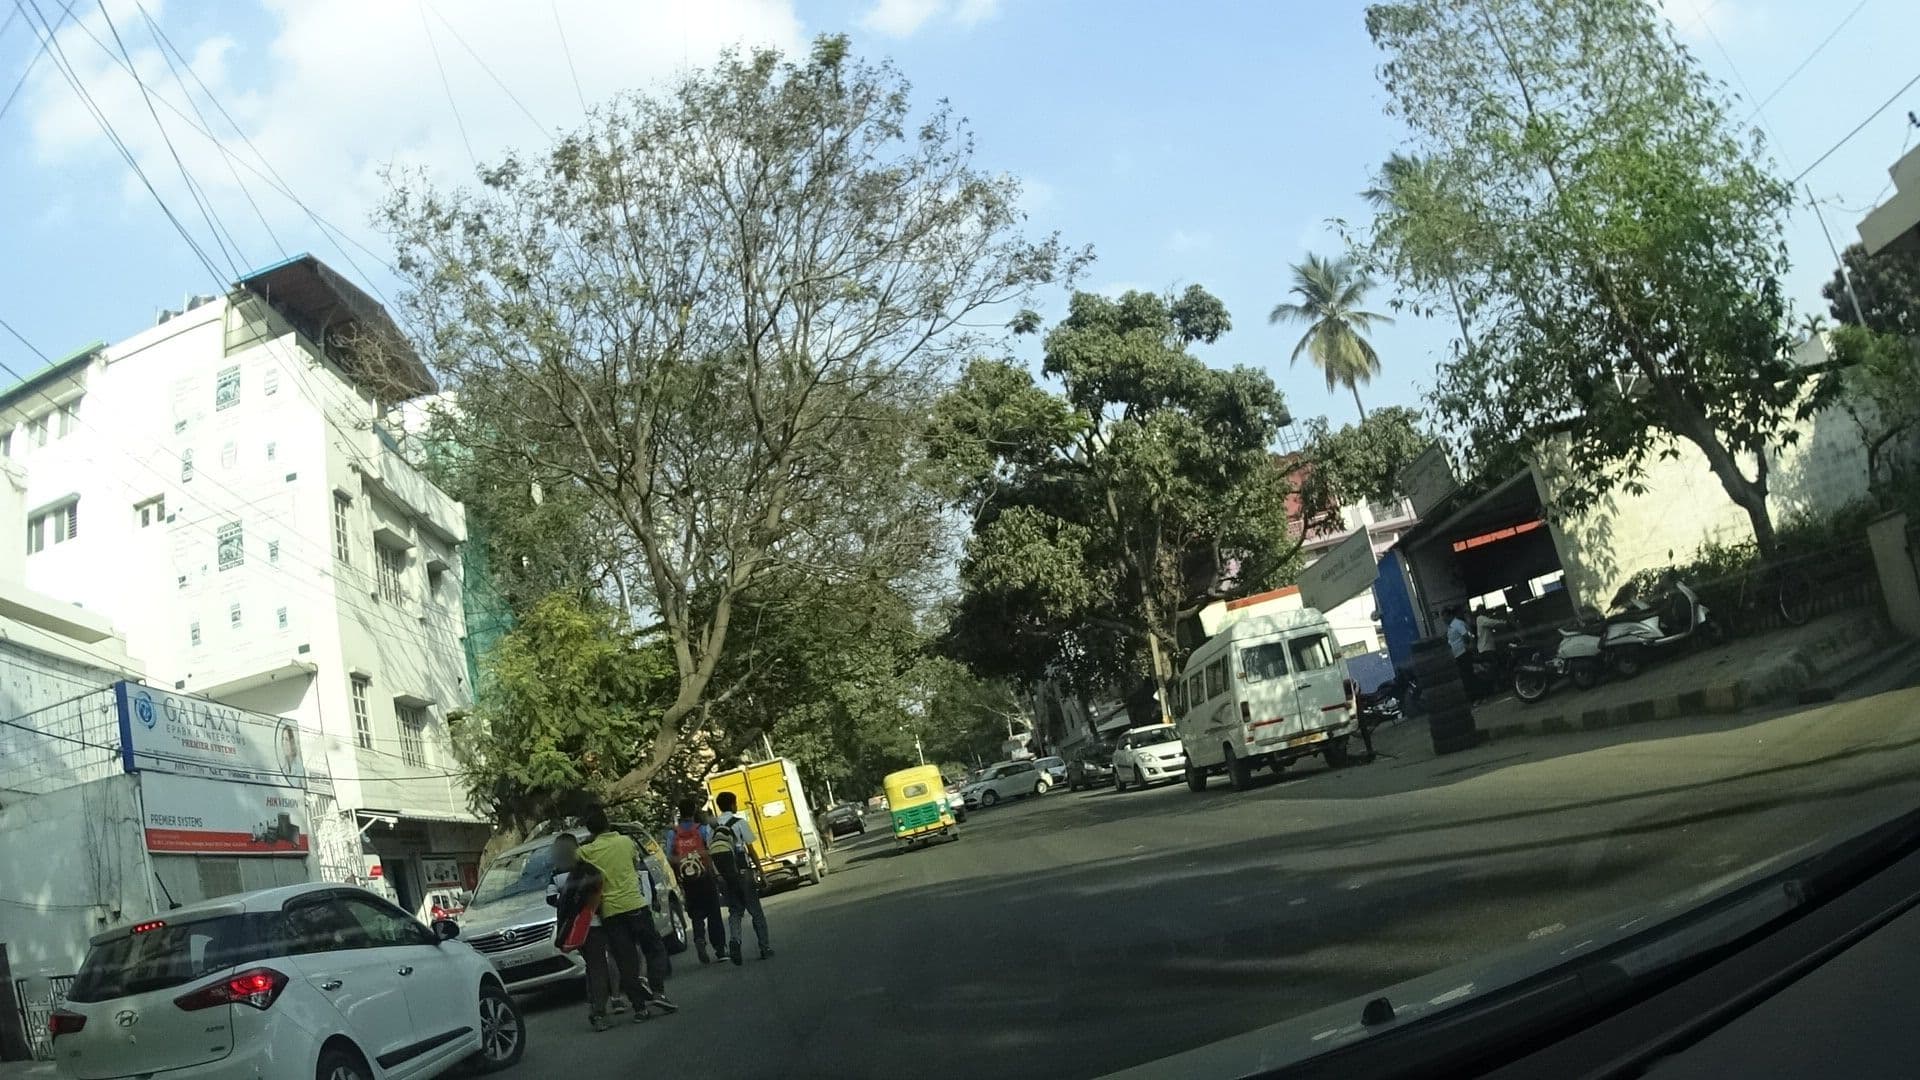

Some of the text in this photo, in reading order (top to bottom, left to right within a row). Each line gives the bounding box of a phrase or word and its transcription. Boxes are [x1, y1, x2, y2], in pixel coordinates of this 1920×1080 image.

[163, 696, 241, 734] GALAXY
[181, 738, 237, 755] PREMIER SYSTEMS
[266, 796, 299, 809] HIKVISION
[150, 813, 203, 828] PREMIER SYSTEMS
